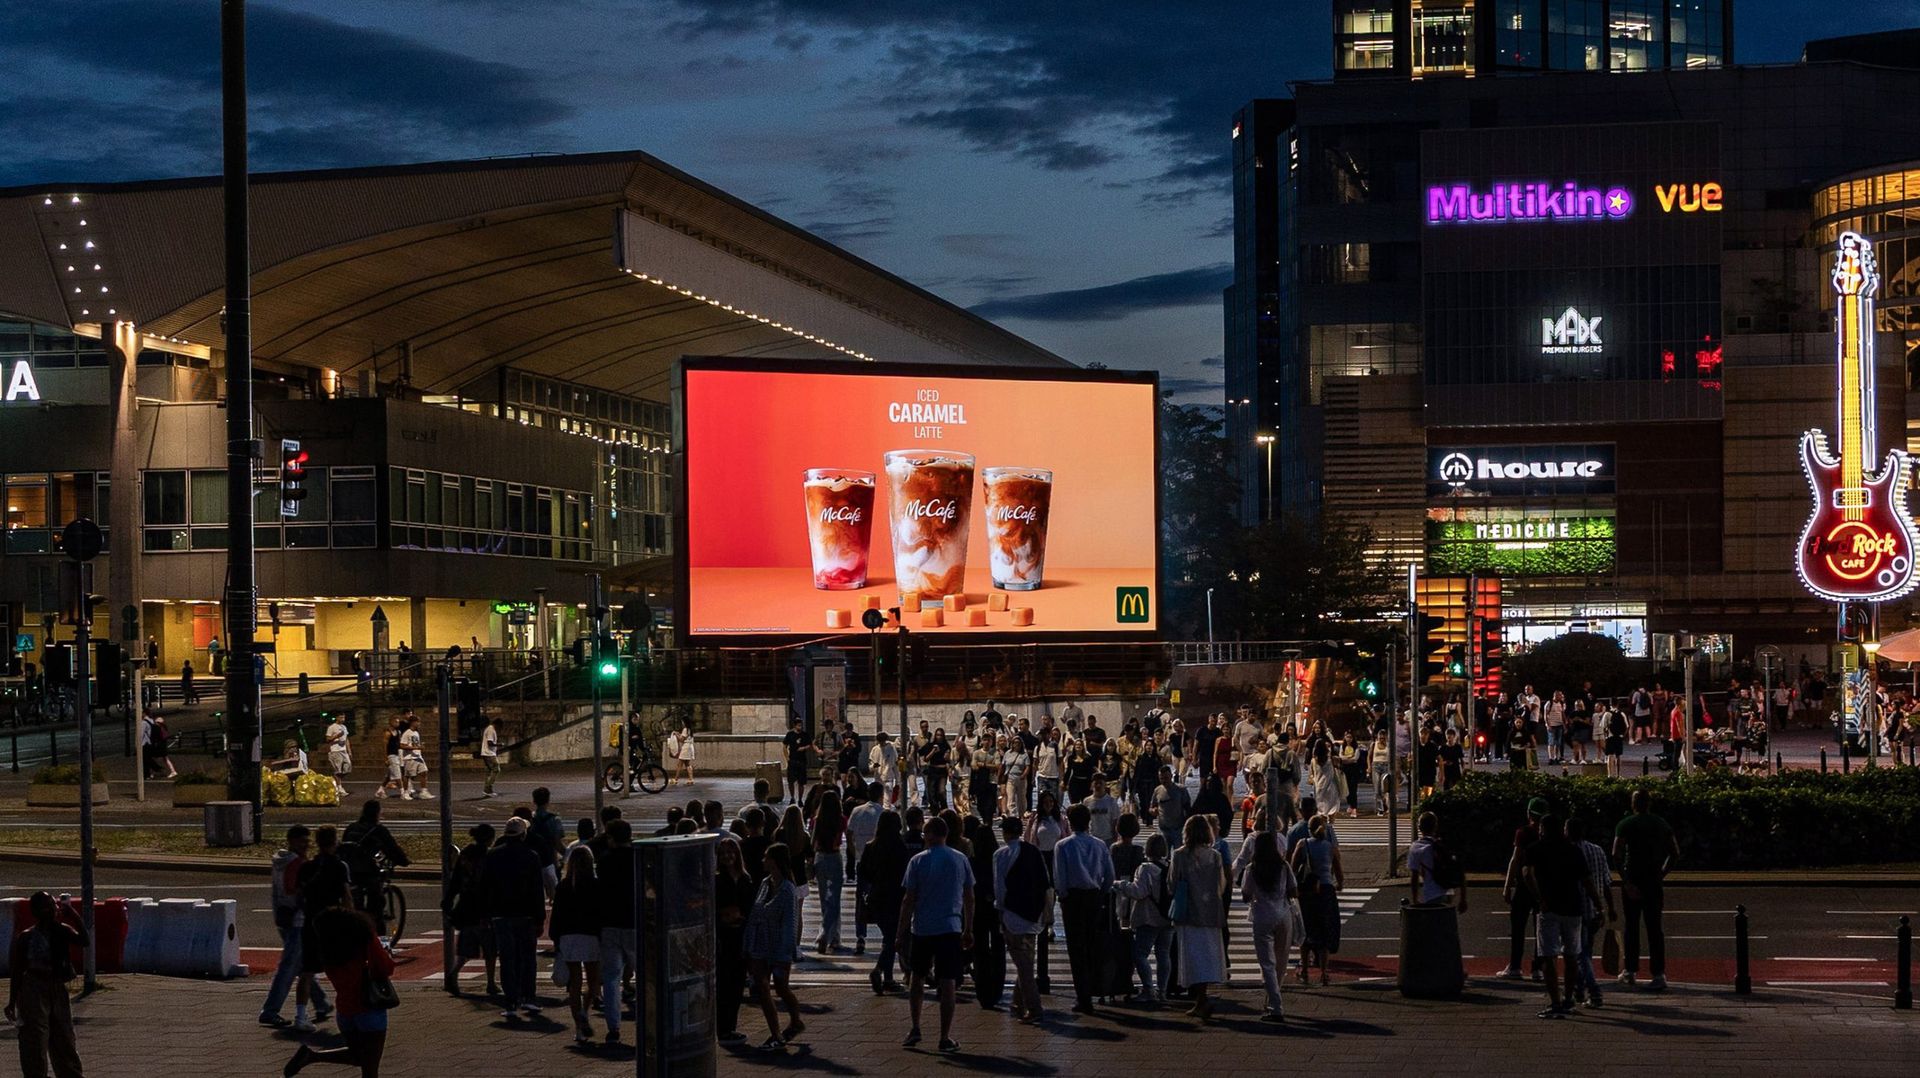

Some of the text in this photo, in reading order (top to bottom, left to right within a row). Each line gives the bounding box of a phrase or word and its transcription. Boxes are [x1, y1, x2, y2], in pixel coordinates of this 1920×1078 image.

[1428, 181, 1633, 221] Multikino
[1655, 181, 1724, 213] vue
[1542, 306, 1603, 345] MAX
[1541, 345, 1603, 354] PREMIUM BURGERS
[0, 360, 41, 401] A
[916, 388, 940, 402] ICED
[888, 402, 967, 425] CARAMEL
[914, 425, 943, 439] LATTE
[1477, 458, 1603, 479] house
[903, 498, 957, 524] McCafé
[1476, 522, 1569, 539] MEDICINE
[1852, 532, 1897, 558] Rock
[1841, 558, 1866, 569] CAFE
[1501, 608, 1532, 618] HORA
[1579, 607, 1624, 617] SEPHORA
